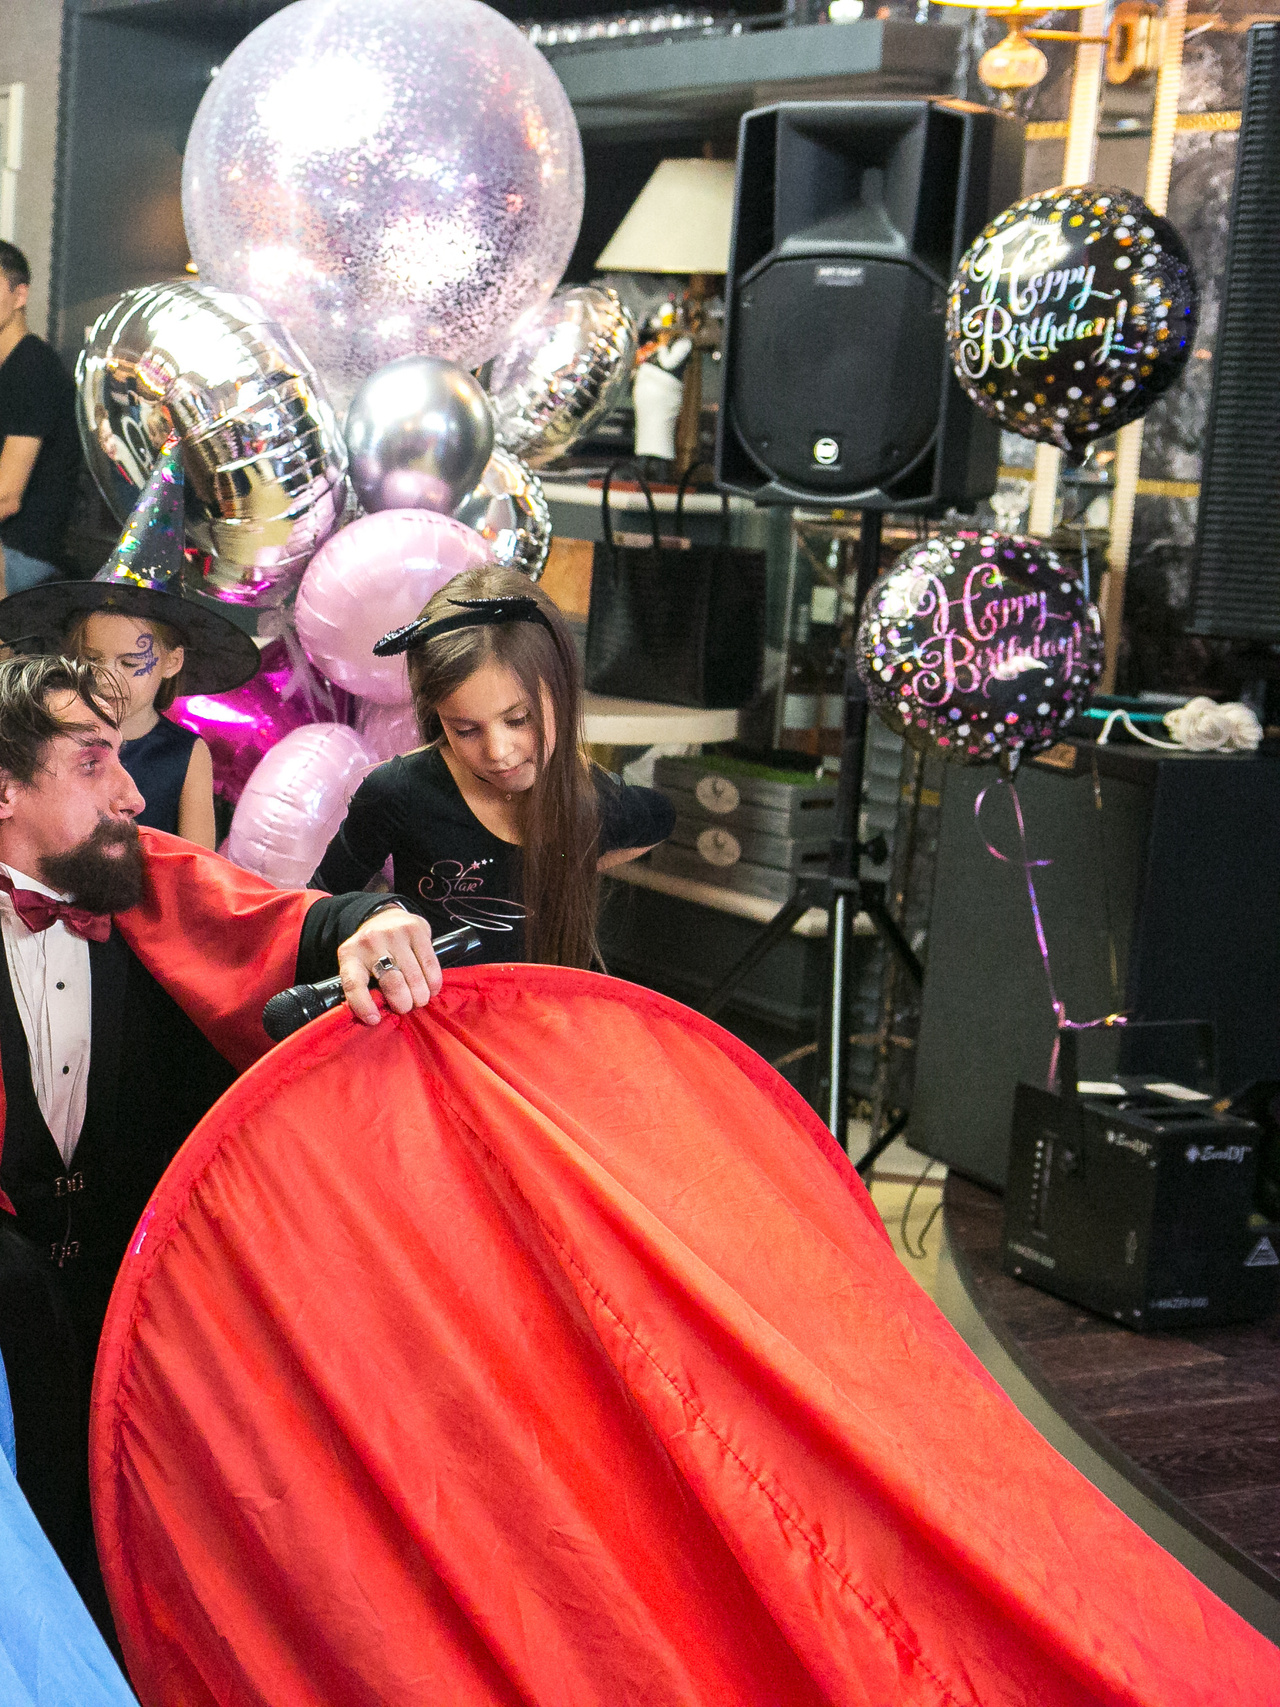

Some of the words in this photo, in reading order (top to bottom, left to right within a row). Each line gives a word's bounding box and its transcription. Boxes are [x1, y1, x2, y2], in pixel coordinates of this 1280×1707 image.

[969, 219, 1121, 316] Happy
[959, 298, 1140, 379] Birthday!
[905, 562, 1072, 642] Happy
[912, 627, 1090, 707] Birthday!
